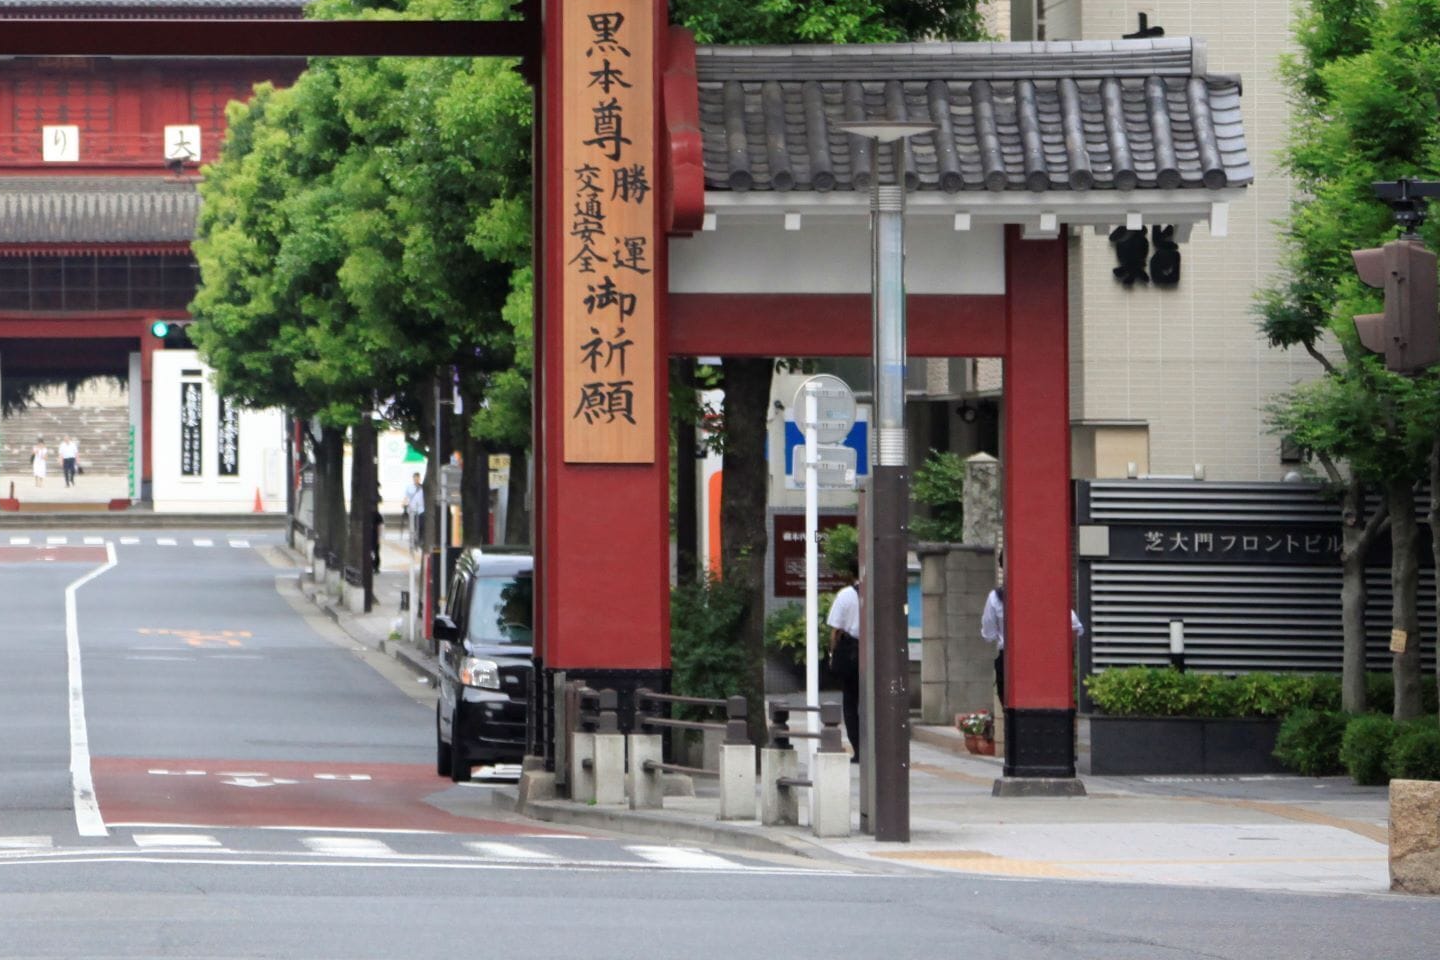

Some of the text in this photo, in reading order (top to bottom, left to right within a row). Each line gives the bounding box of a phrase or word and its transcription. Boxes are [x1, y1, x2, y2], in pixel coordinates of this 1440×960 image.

[568, 163, 607, 273] 交通安全
[610, 163, 652, 275] 勝運
[1145, 532, 1344, 552] 芝大門フロントビル
